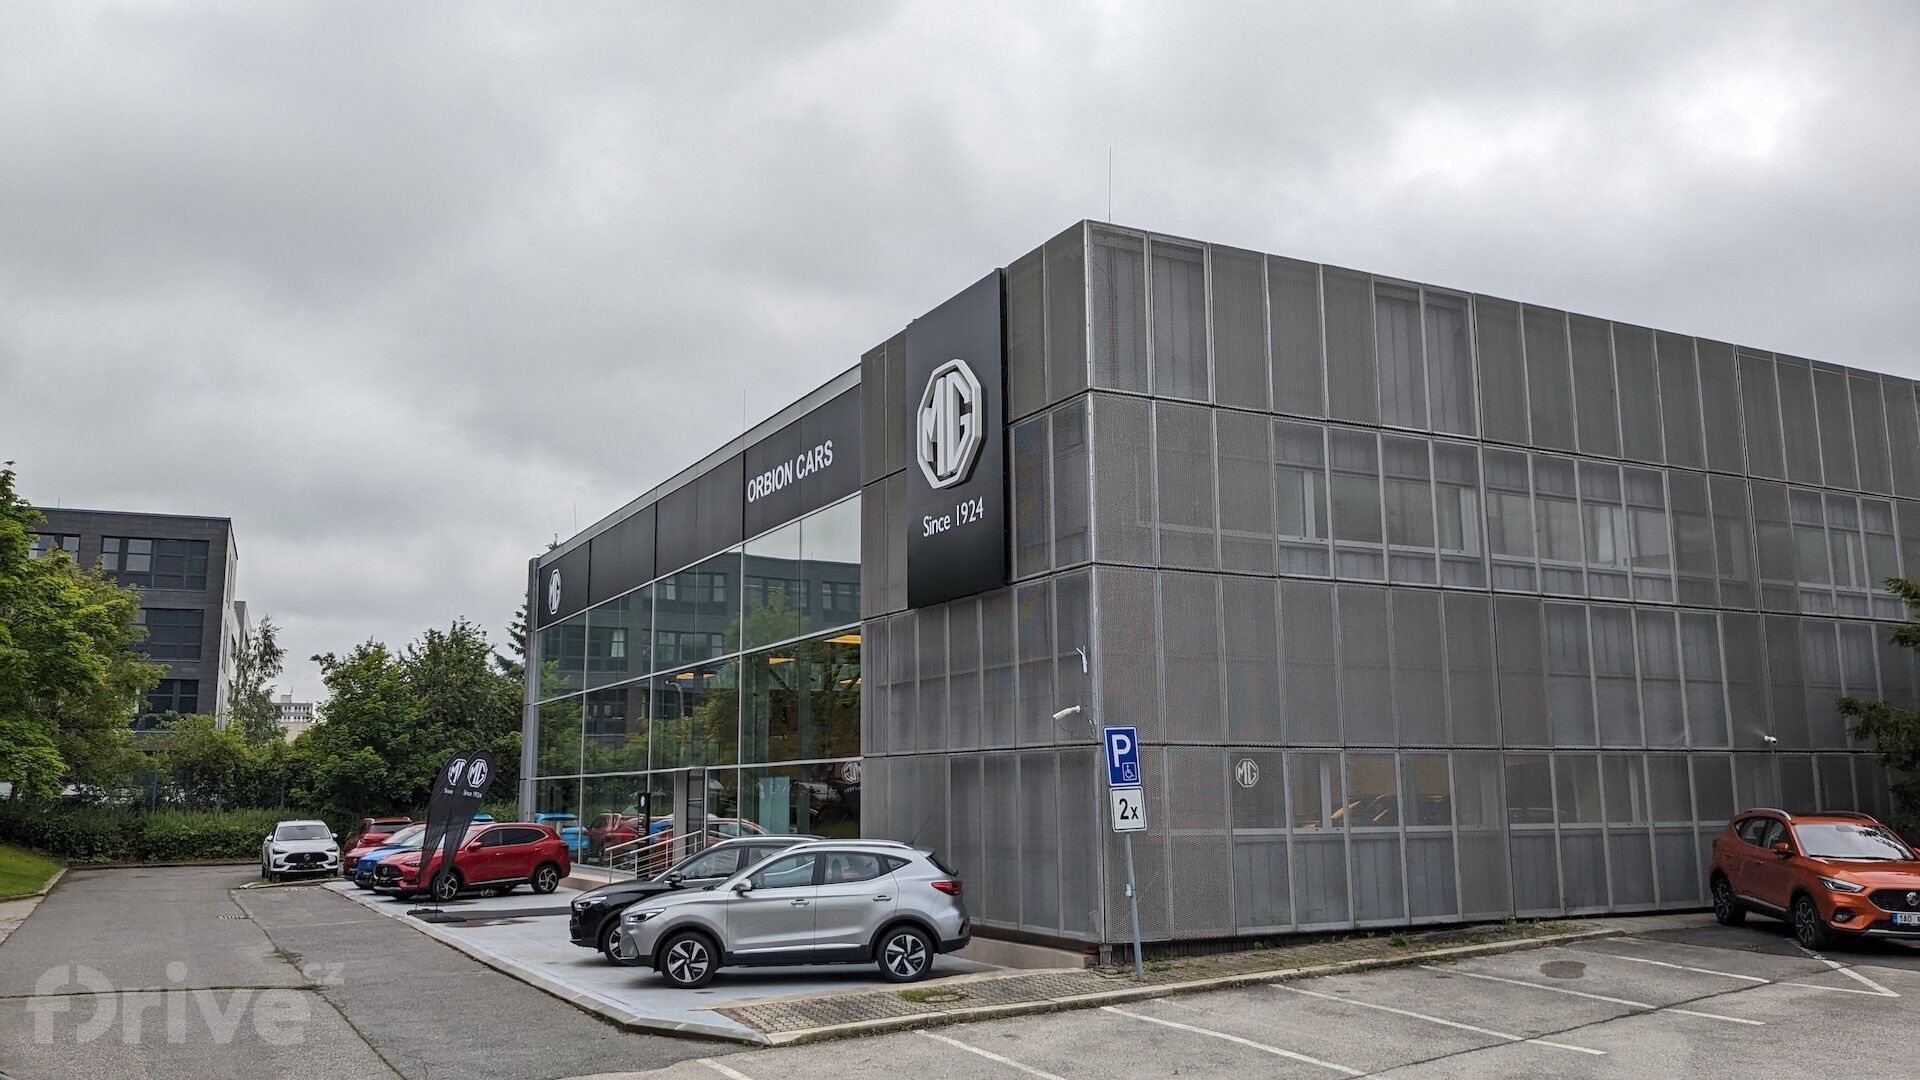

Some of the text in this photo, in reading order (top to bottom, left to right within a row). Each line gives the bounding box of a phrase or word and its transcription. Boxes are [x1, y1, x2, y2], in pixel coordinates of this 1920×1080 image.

[919, 364, 976, 482] MG
[747, 439, 833, 503] ORBION CARS
[923, 496, 984, 537] Since 1924
[549, 570, 561, 614] MG
[1111, 734, 1131, 768] P
[468, 760, 487, 786] MG
[1237, 760, 1257, 786] MG
[1119, 798, 1139, 820] 2x
